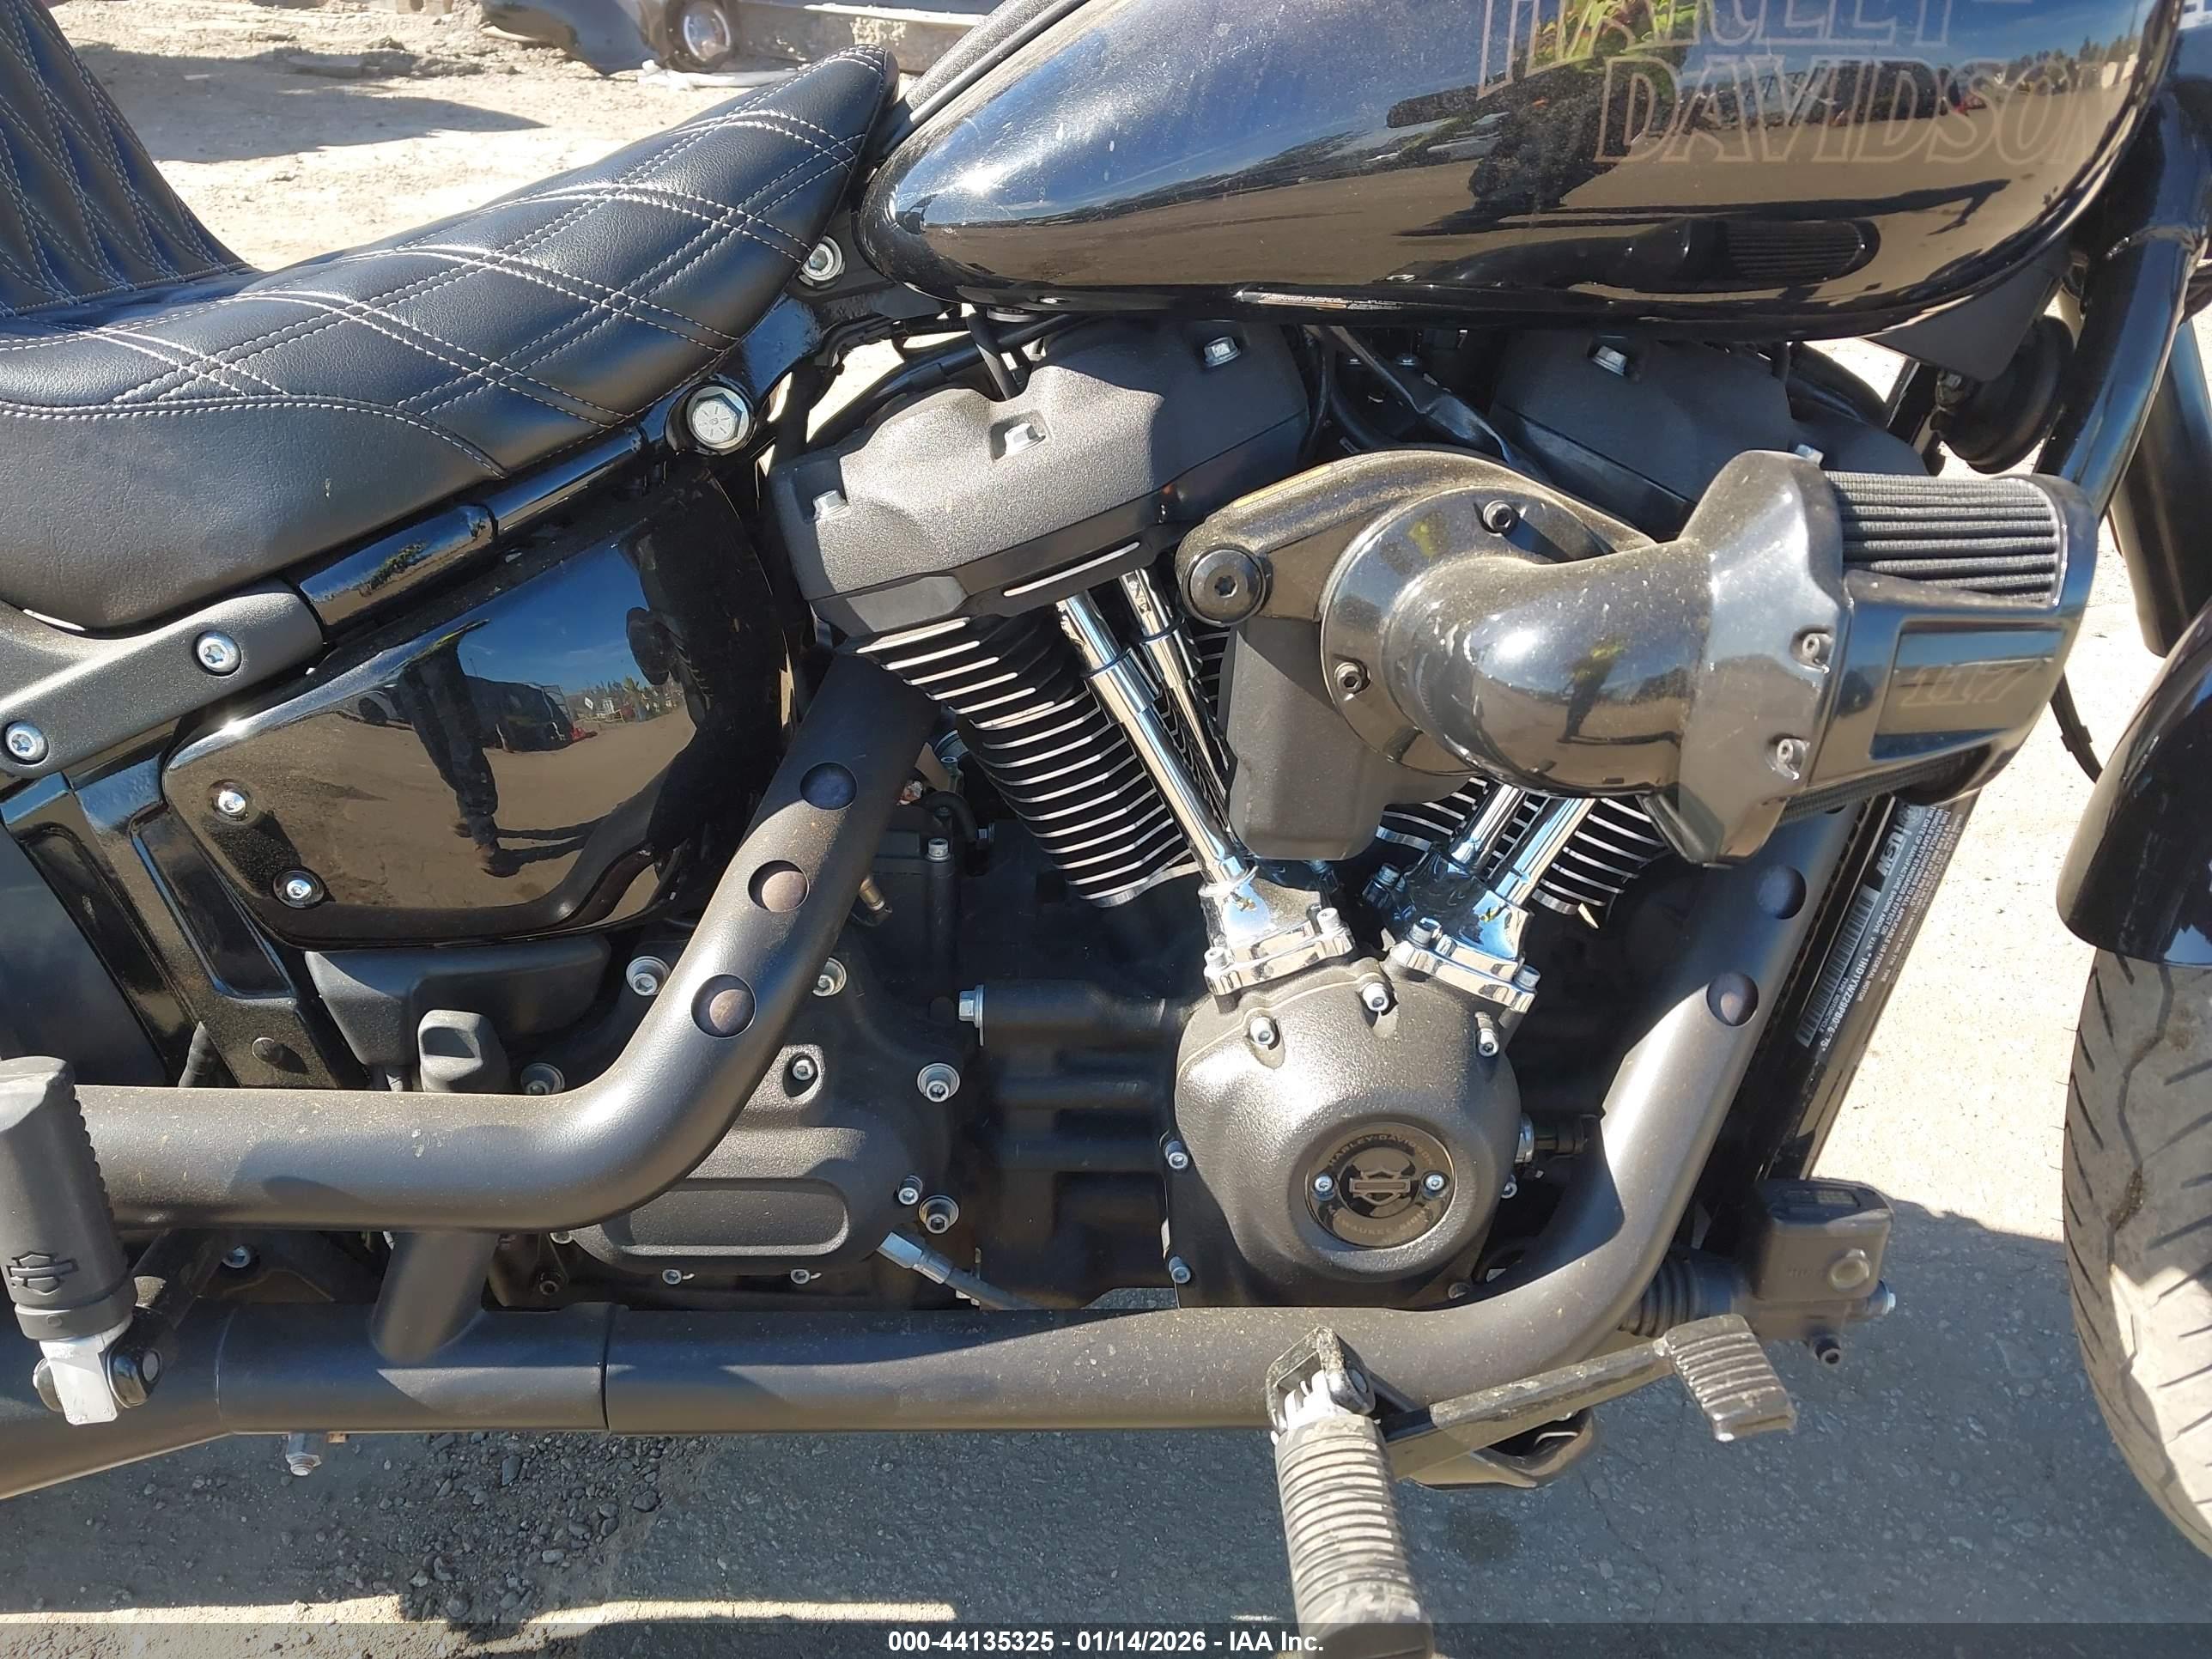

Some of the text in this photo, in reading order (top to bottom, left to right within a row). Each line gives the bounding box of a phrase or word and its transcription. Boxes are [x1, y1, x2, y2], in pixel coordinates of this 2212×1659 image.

[1900, 661, 2041, 707] 117
[1918, 818, 1930, 835] DATE
[1927, 824, 1944, 851] VEHICLE
[1914, 836, 1923, 844] OF
[1917, 835, 1931, 858] SAFETY
[1899, 858, 1920, 895] STANDARDS
[1911, 851, 1932, 885] CONFORMS
[1901, 895, 1911, 908] ALL
[1907, 886, 1916, 895] TO
[1885, 902, 1900, 925] EFFECT
[1880, 925, 1889, 935] ON
[1884, 908, 1905, 944] APPLICABLE
[1880, 944, 1888, 952] US
[1867, 953, 1884, 980] FEDERAL
